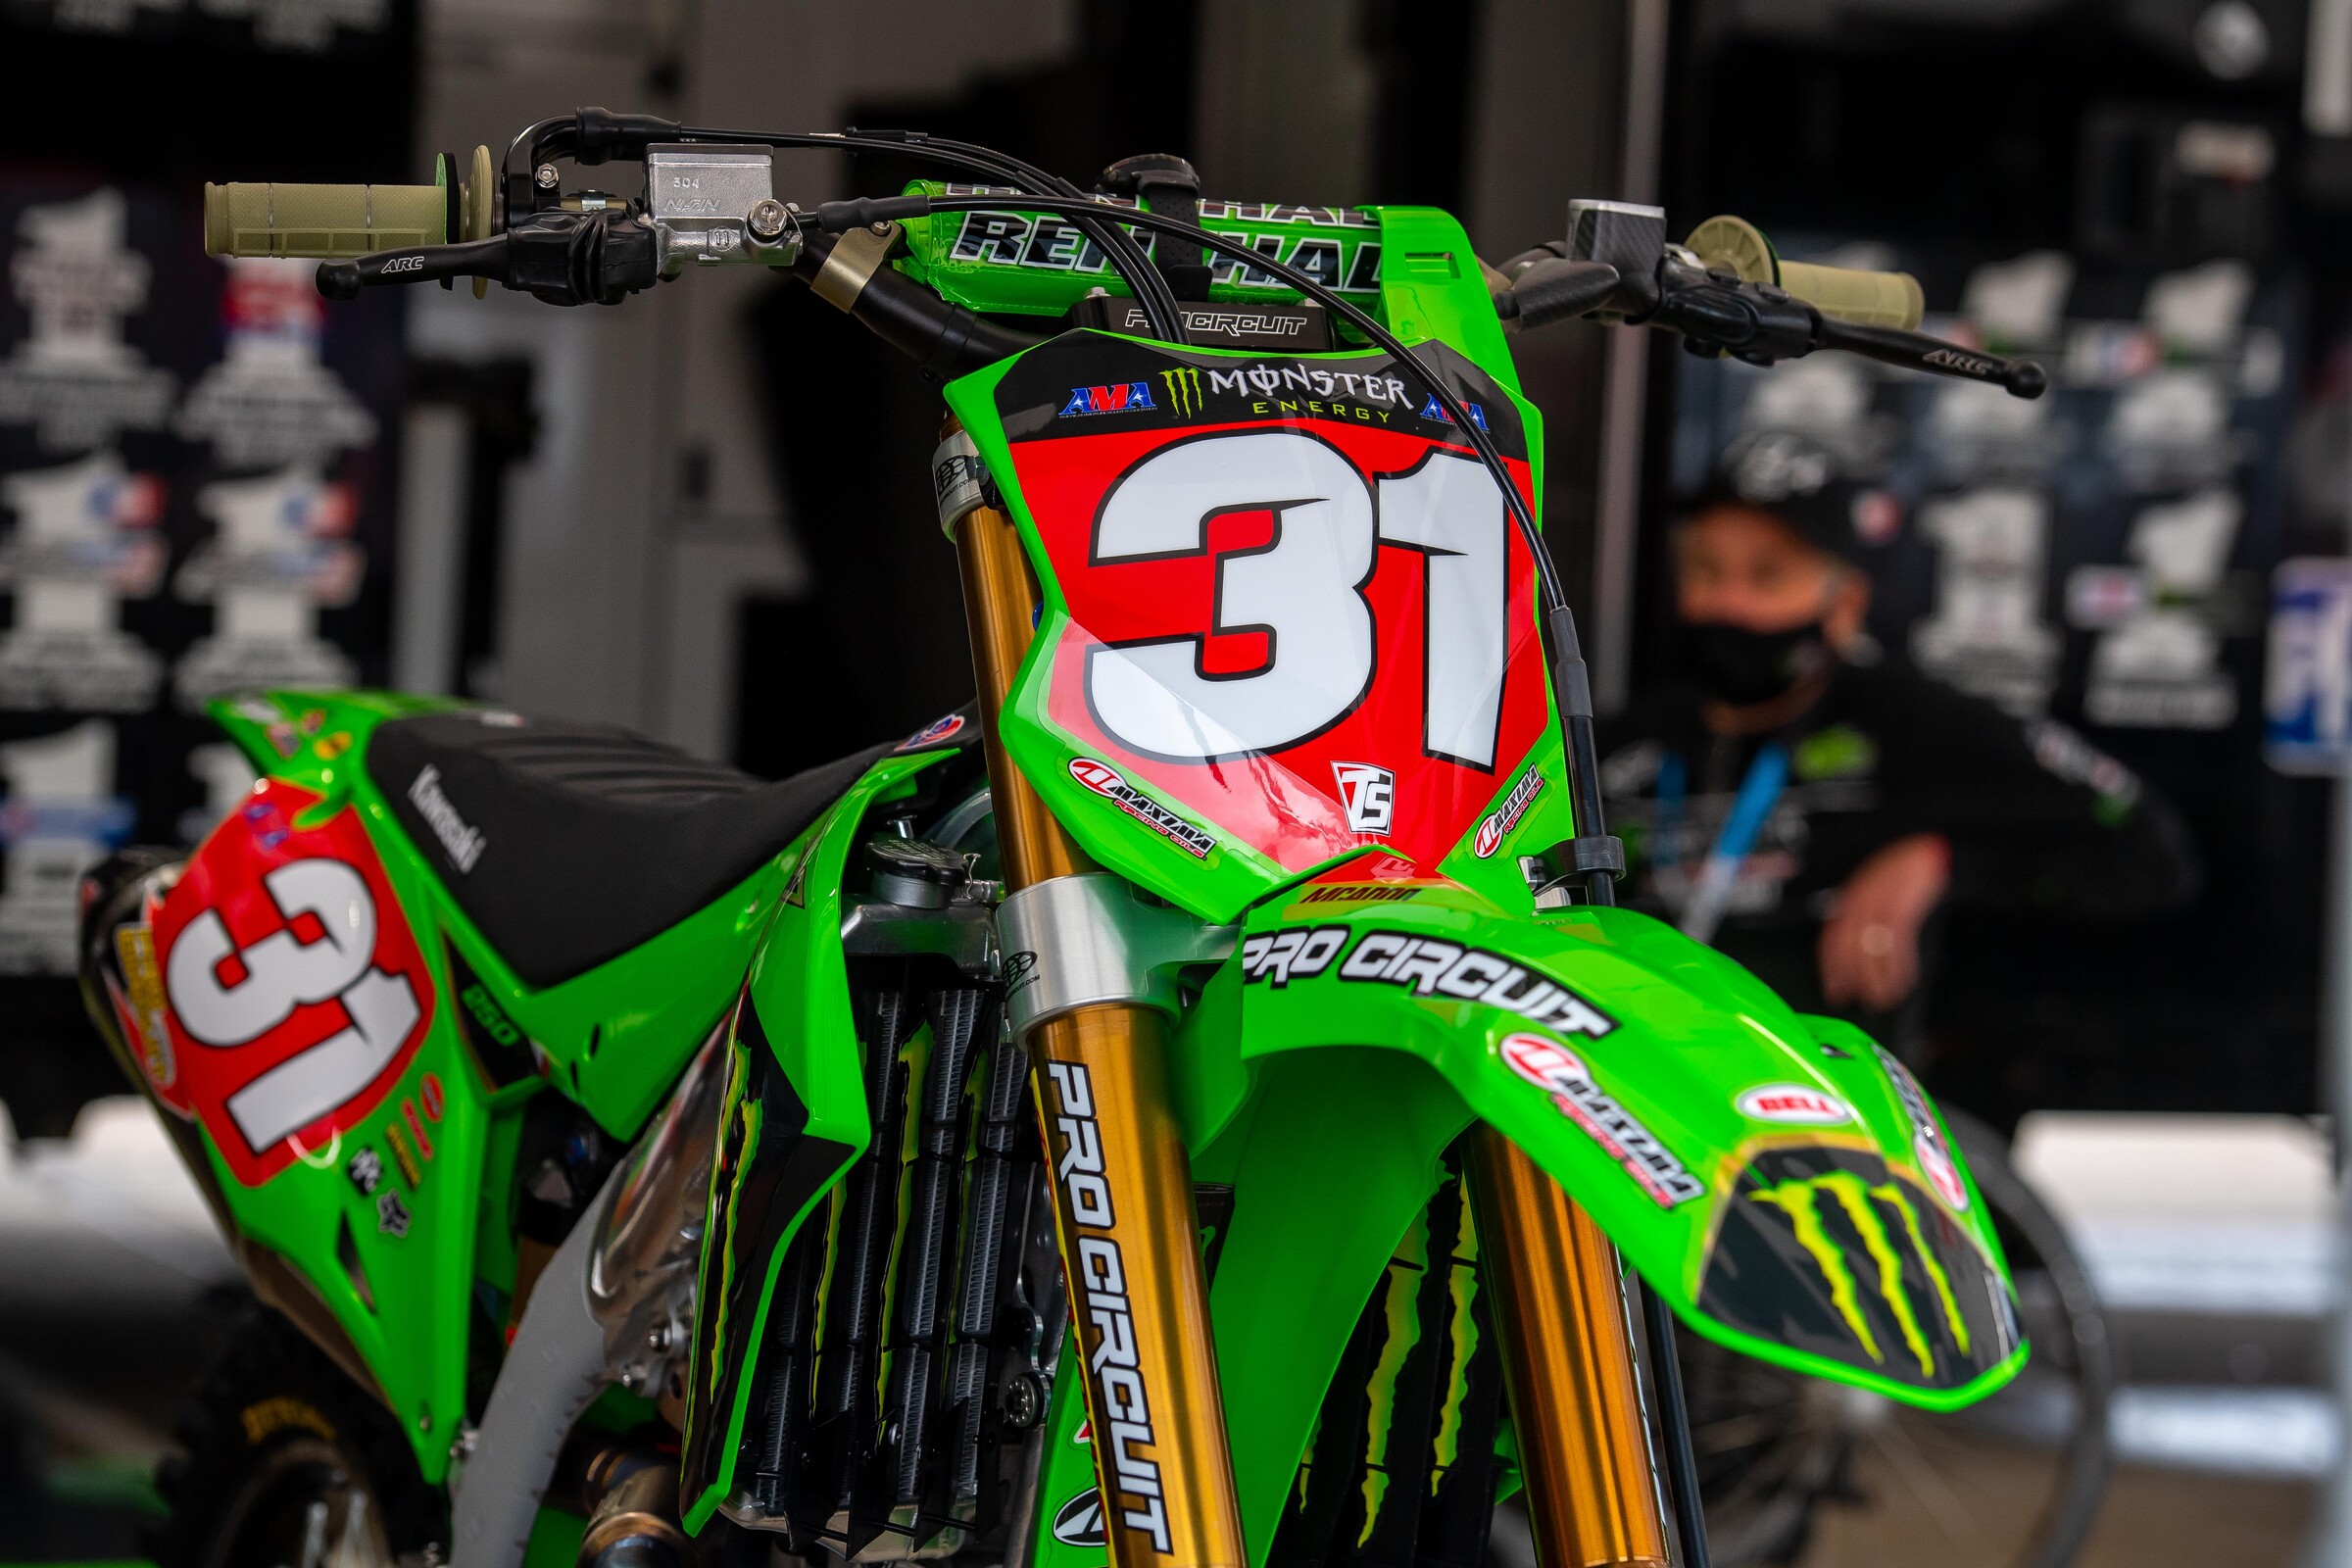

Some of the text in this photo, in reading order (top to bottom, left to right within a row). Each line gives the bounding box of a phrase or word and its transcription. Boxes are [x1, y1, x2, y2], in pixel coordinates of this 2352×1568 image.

[380, 256, 425, 274] ARC
[1207, 364, 1415, 411] MONSTER
[1922, 348, 1994, 376] ARC
[1058, 381, 1156, 416] AMA
[1252, 400, 1391, 424] ENERGY
[1084, 425, 1509, 775] 31
[1105, 784, 1218, 853] MAXIMA
[1113, 799, 1206, 859] RACING OILS
[1493, 763, 1541, 834] MAXIMA
[165, 856, 423, 1158] 31
[1243, 926, 1618, 1039] PRO CIRCUIT
[1756, 1096, 1841, 1119] BELL
[1047, 1061, 1115, 1229] PRO
[1078, 1236, 1174, 1555] CIRCUIT
